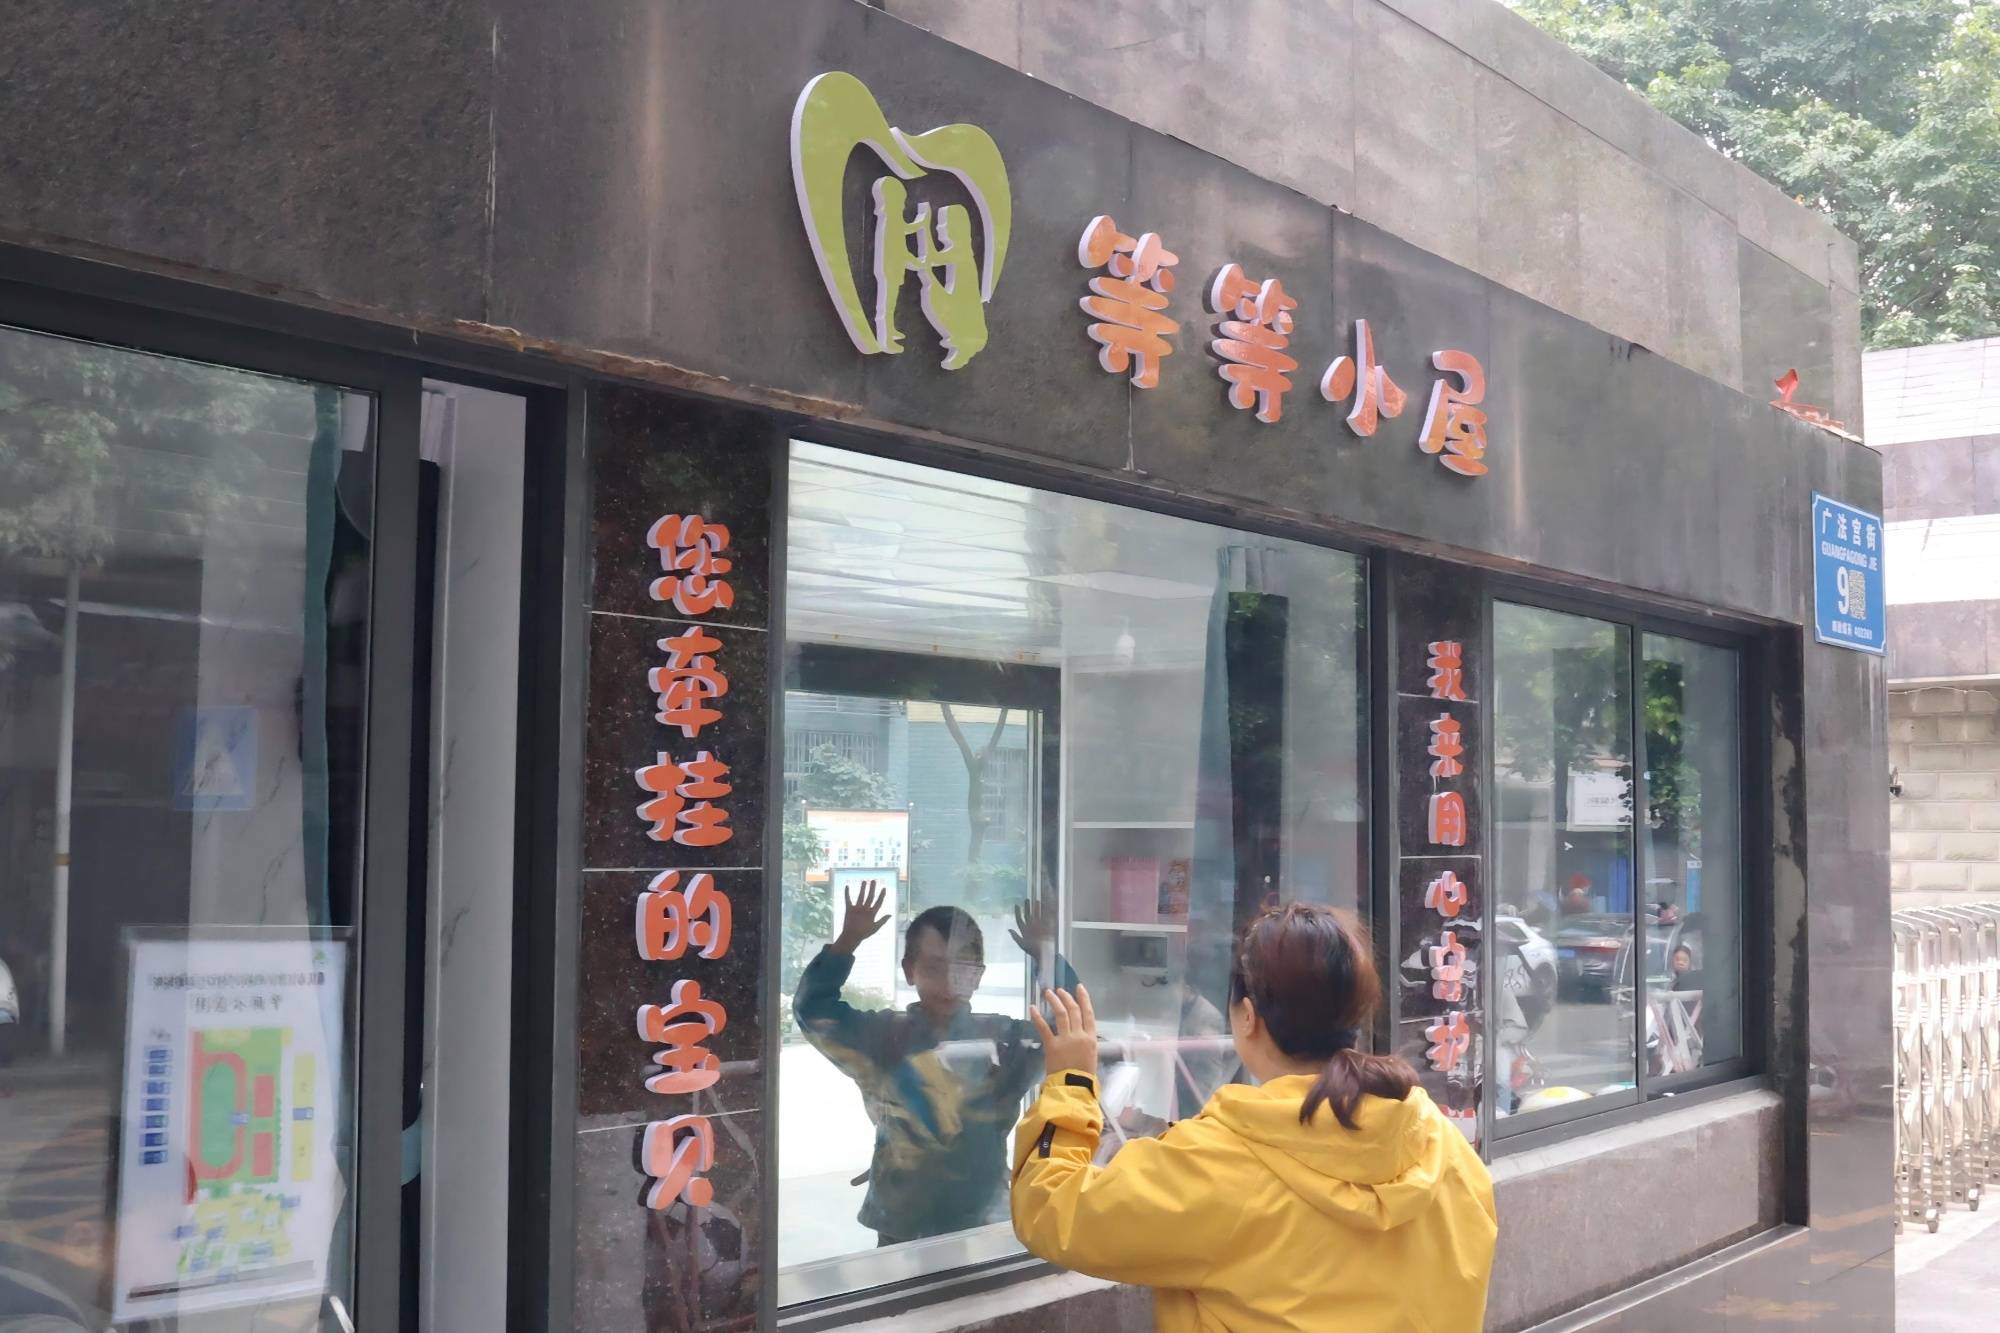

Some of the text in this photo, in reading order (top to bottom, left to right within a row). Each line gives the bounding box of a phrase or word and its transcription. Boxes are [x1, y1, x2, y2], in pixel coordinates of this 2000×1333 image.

[1078, 215, 1488, 477] 等等小屋
[635, 513, 733, 1210] 您牵挂的宝贝
[1425, 639, 1471, 1072] 我来用心守护
